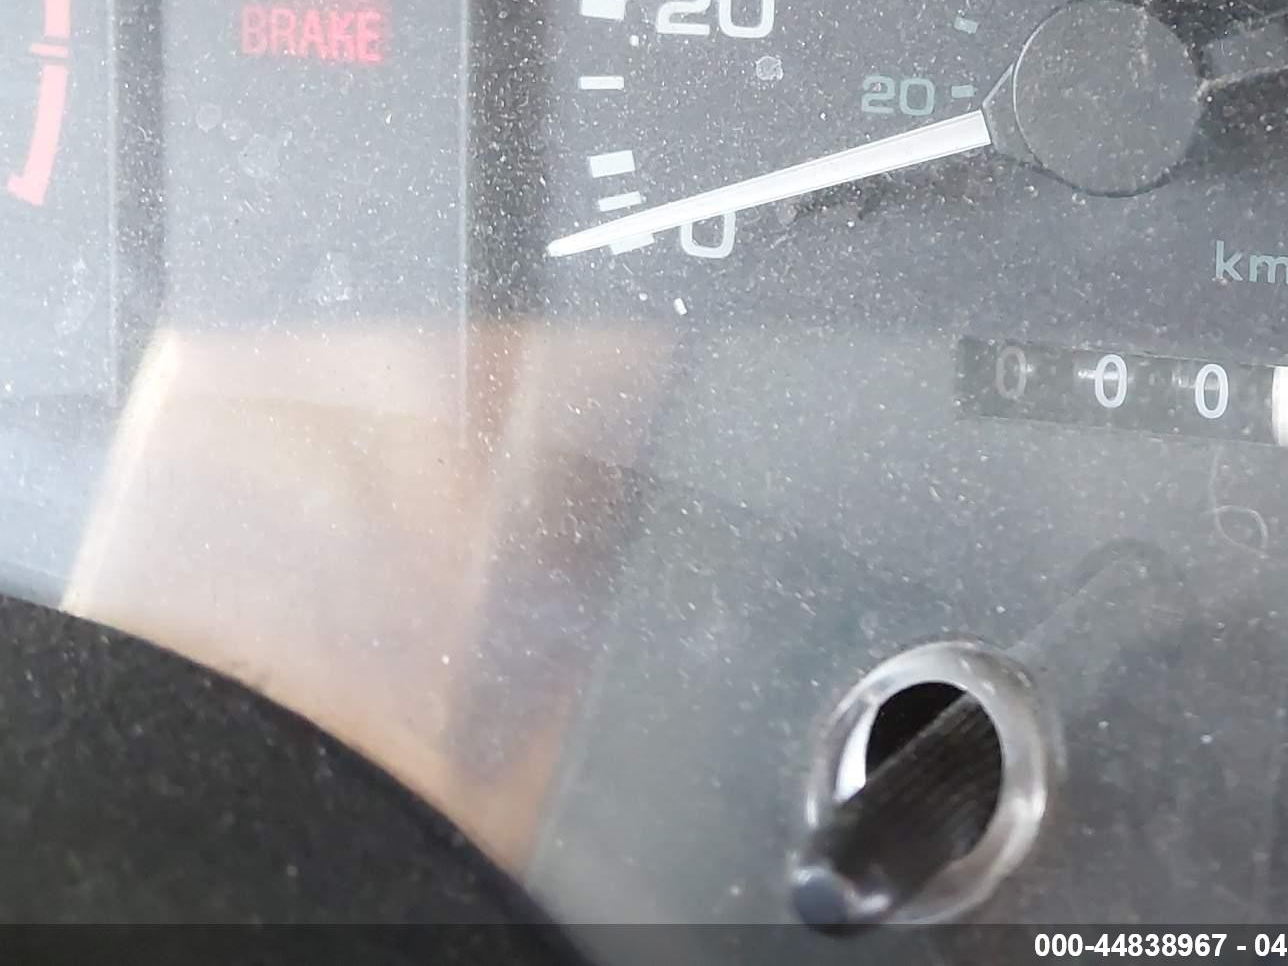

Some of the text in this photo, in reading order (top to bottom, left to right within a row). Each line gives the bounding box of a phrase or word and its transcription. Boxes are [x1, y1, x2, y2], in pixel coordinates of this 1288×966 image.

[241, 4, 383, 65] BRAKE
[861, 75, 936, 116] 20
[680, 211, 736, 259] 0
